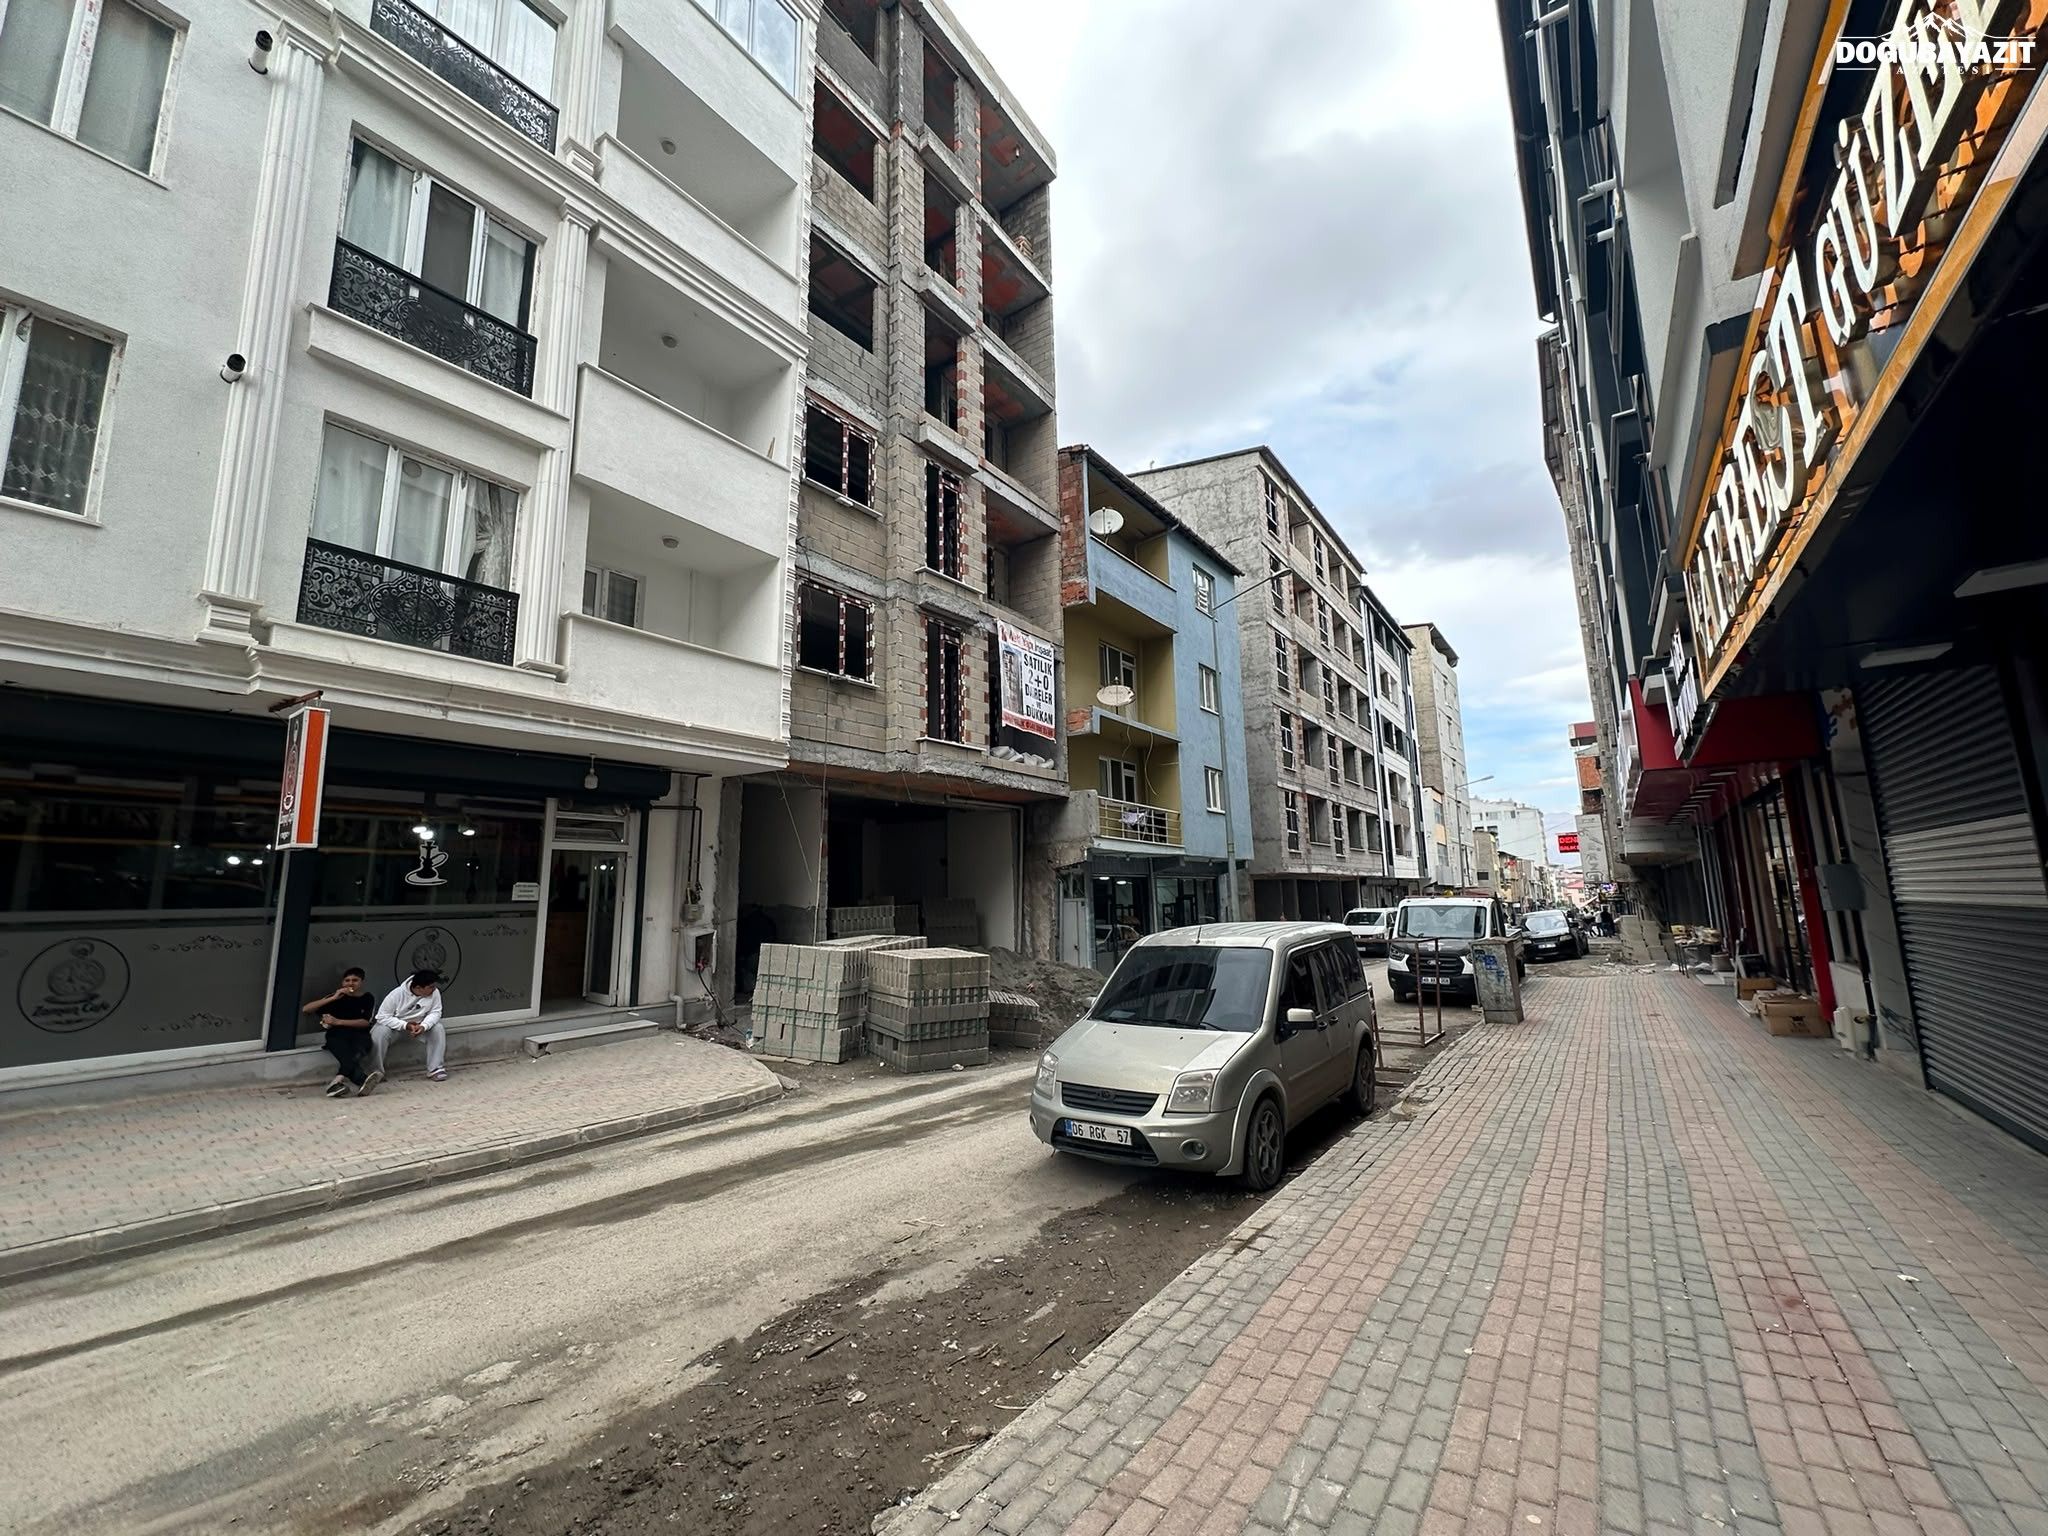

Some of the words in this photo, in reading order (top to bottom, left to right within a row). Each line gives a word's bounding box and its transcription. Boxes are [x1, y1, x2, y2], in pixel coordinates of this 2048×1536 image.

[1024, 654, 1052, 676] SATILIK
[1026, 704, 1053, 725] DÜKKAN
[1072, 1123, 1084, 1136] 06
[1089, 1126, 1107, 1140] RGK
[1116, 1130, 1129, 1143] 57
